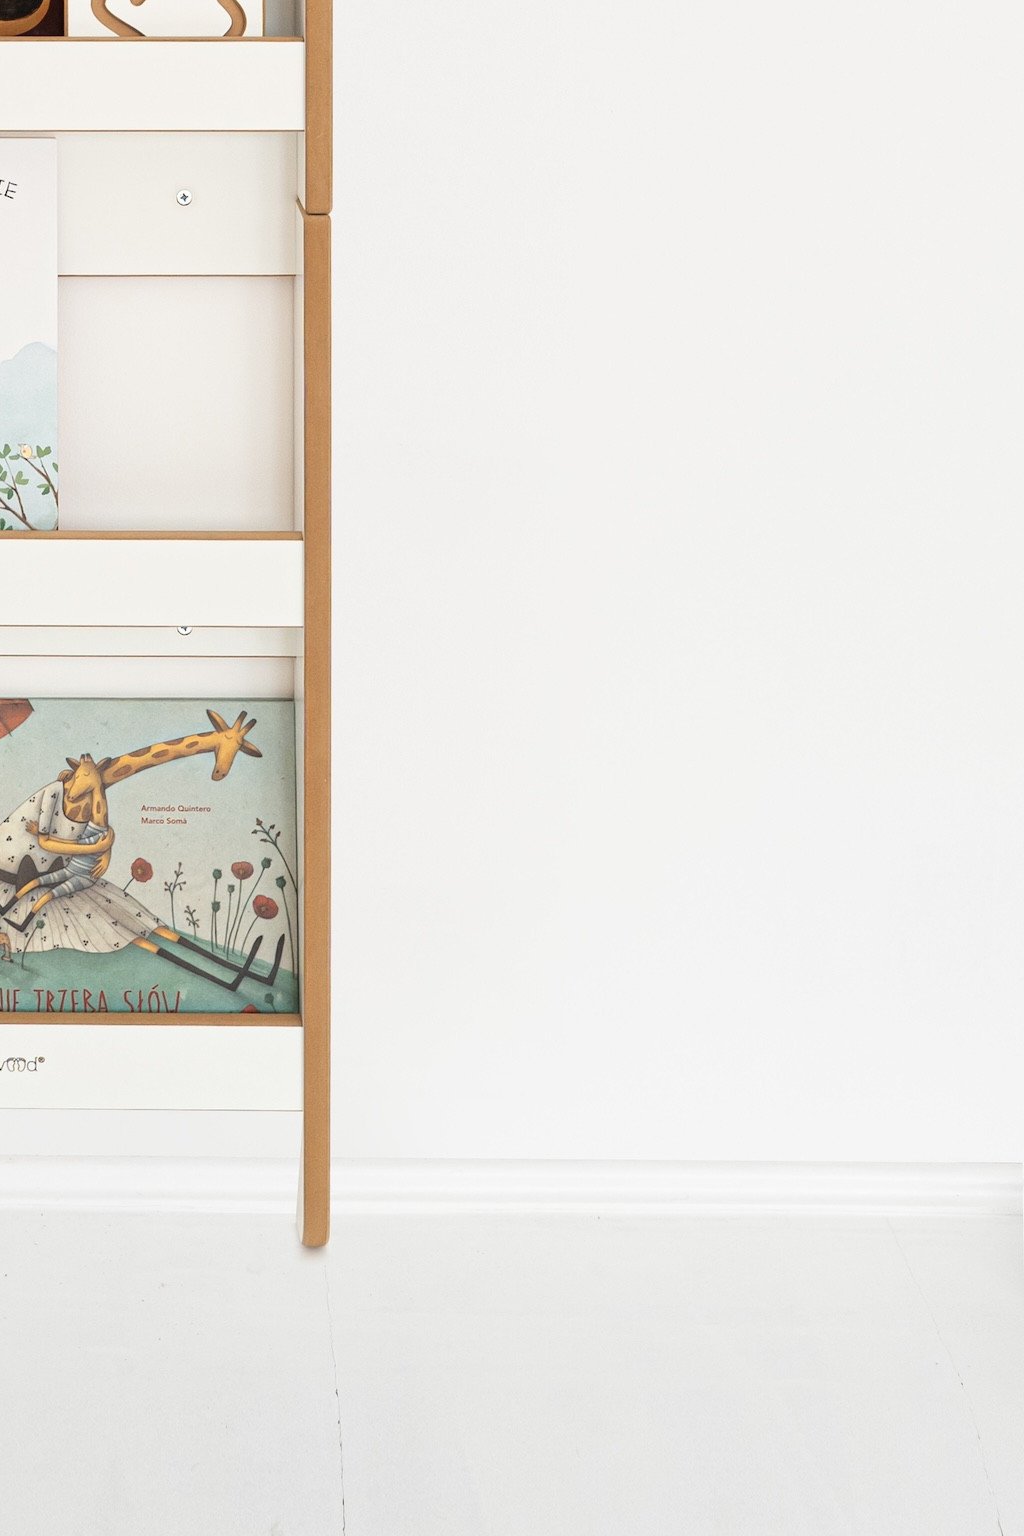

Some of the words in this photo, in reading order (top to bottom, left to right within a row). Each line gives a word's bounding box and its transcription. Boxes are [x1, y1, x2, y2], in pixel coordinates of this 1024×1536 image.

[177, 805, 211, 813] Quintero
[33, 989, 108, 1013] TRZEBA
[124, 984, 180, 1013] SŁÓW
